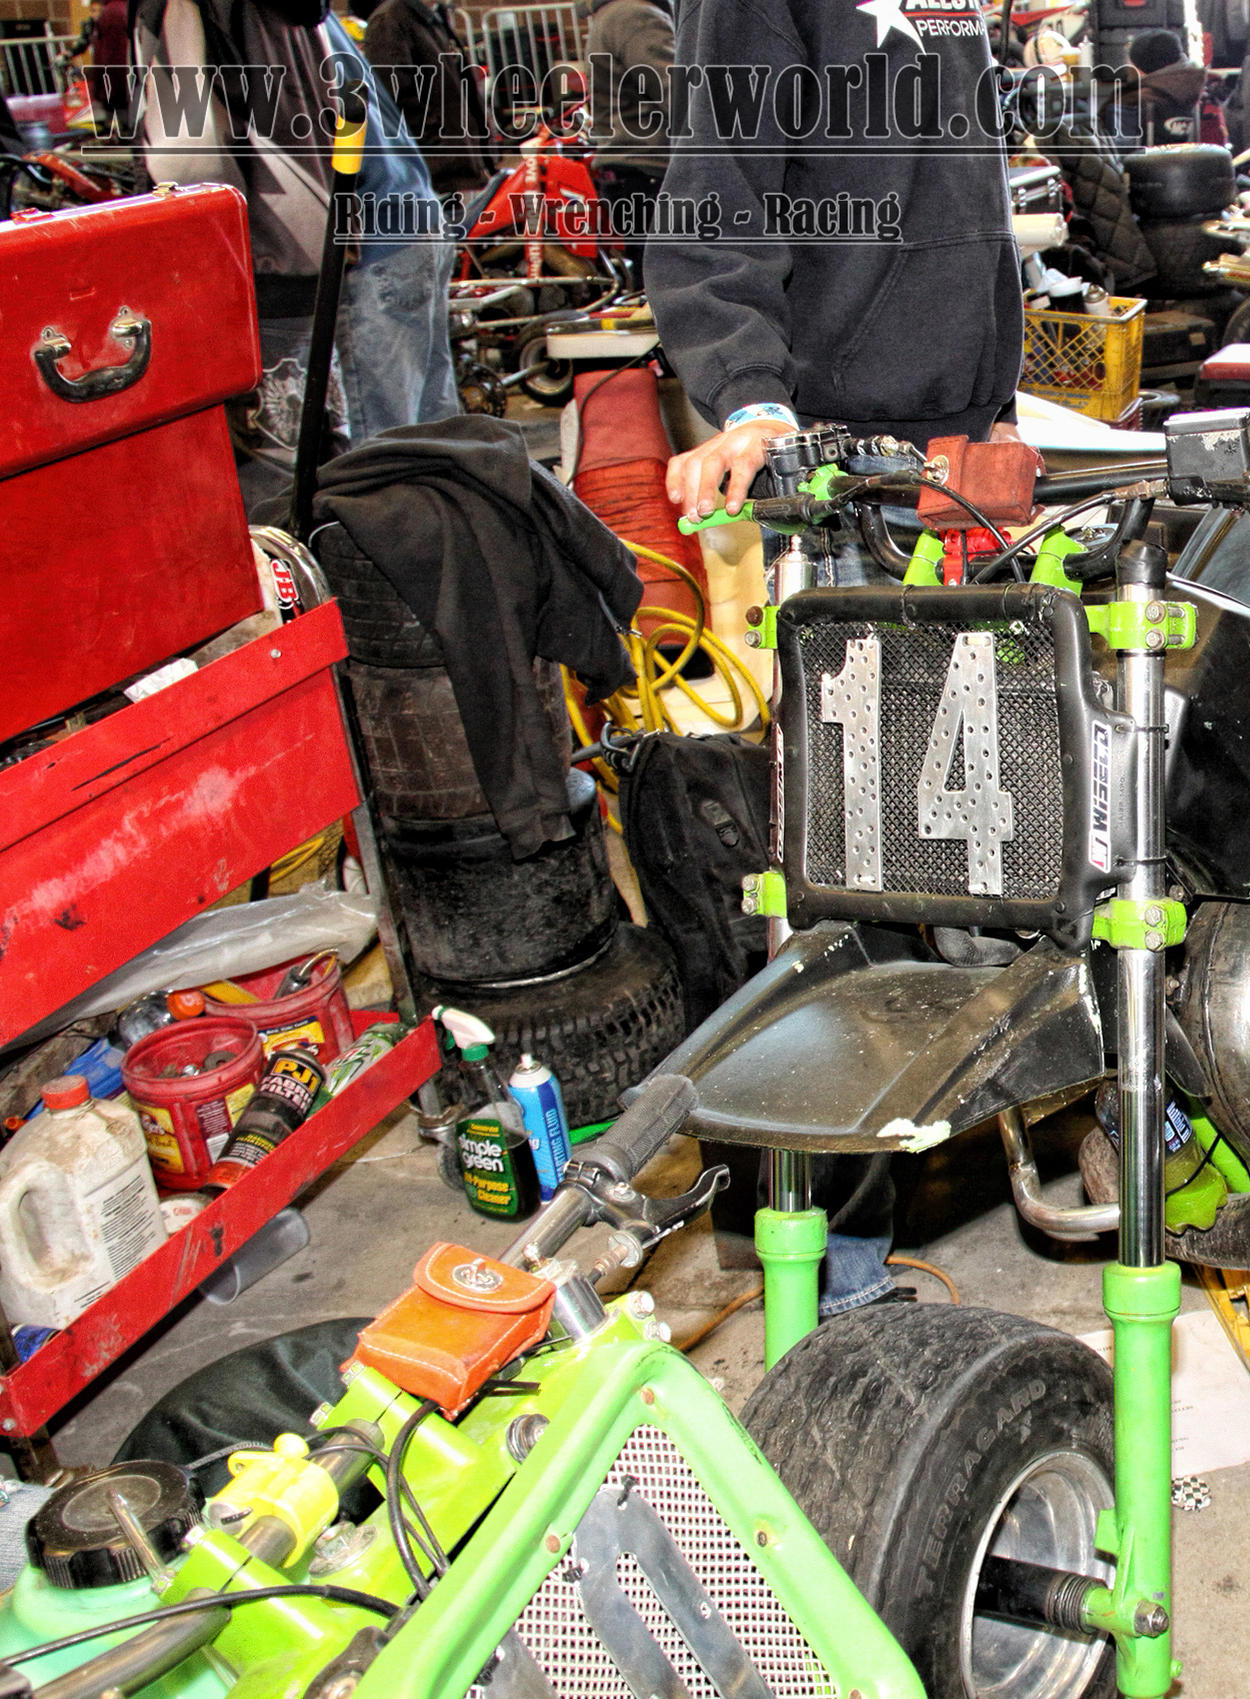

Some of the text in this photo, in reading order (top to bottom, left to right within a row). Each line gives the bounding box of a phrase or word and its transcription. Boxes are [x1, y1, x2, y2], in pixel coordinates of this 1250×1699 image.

[821, 631, 1014, 896] 14
[272, 1058, 320, 1093] PJ1
[462, 1151, 505, 1173] green
